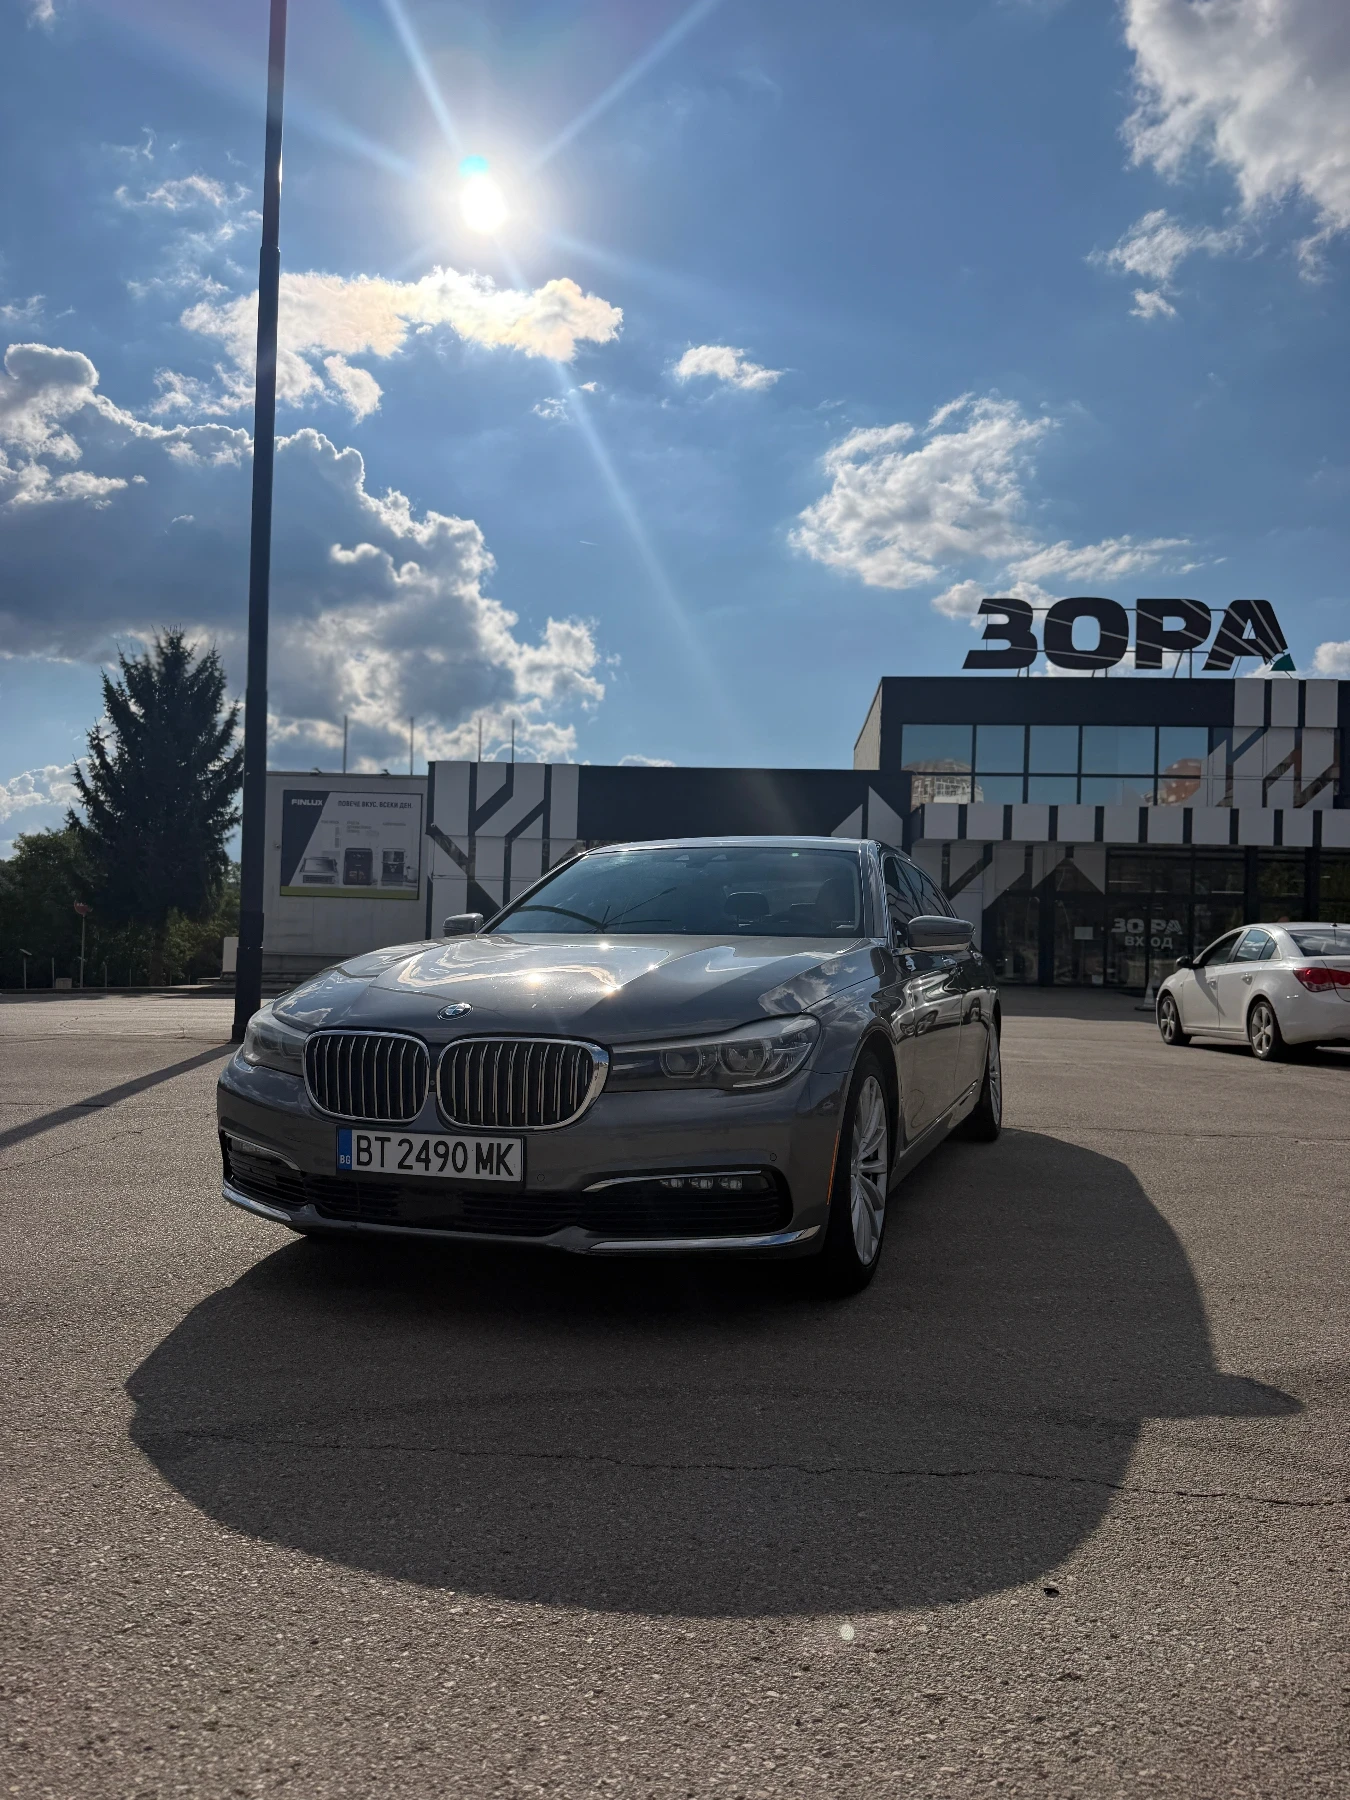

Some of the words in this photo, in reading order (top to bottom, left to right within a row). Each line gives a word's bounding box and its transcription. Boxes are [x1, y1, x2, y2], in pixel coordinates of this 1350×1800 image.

[962, 597, 1296, 671] ЗОРА
[1111, 918, 1183, 934] ЗОРА
[1124, 936, 1173, 950] ВХОД
[339, 1155, 351, 1164] BG
